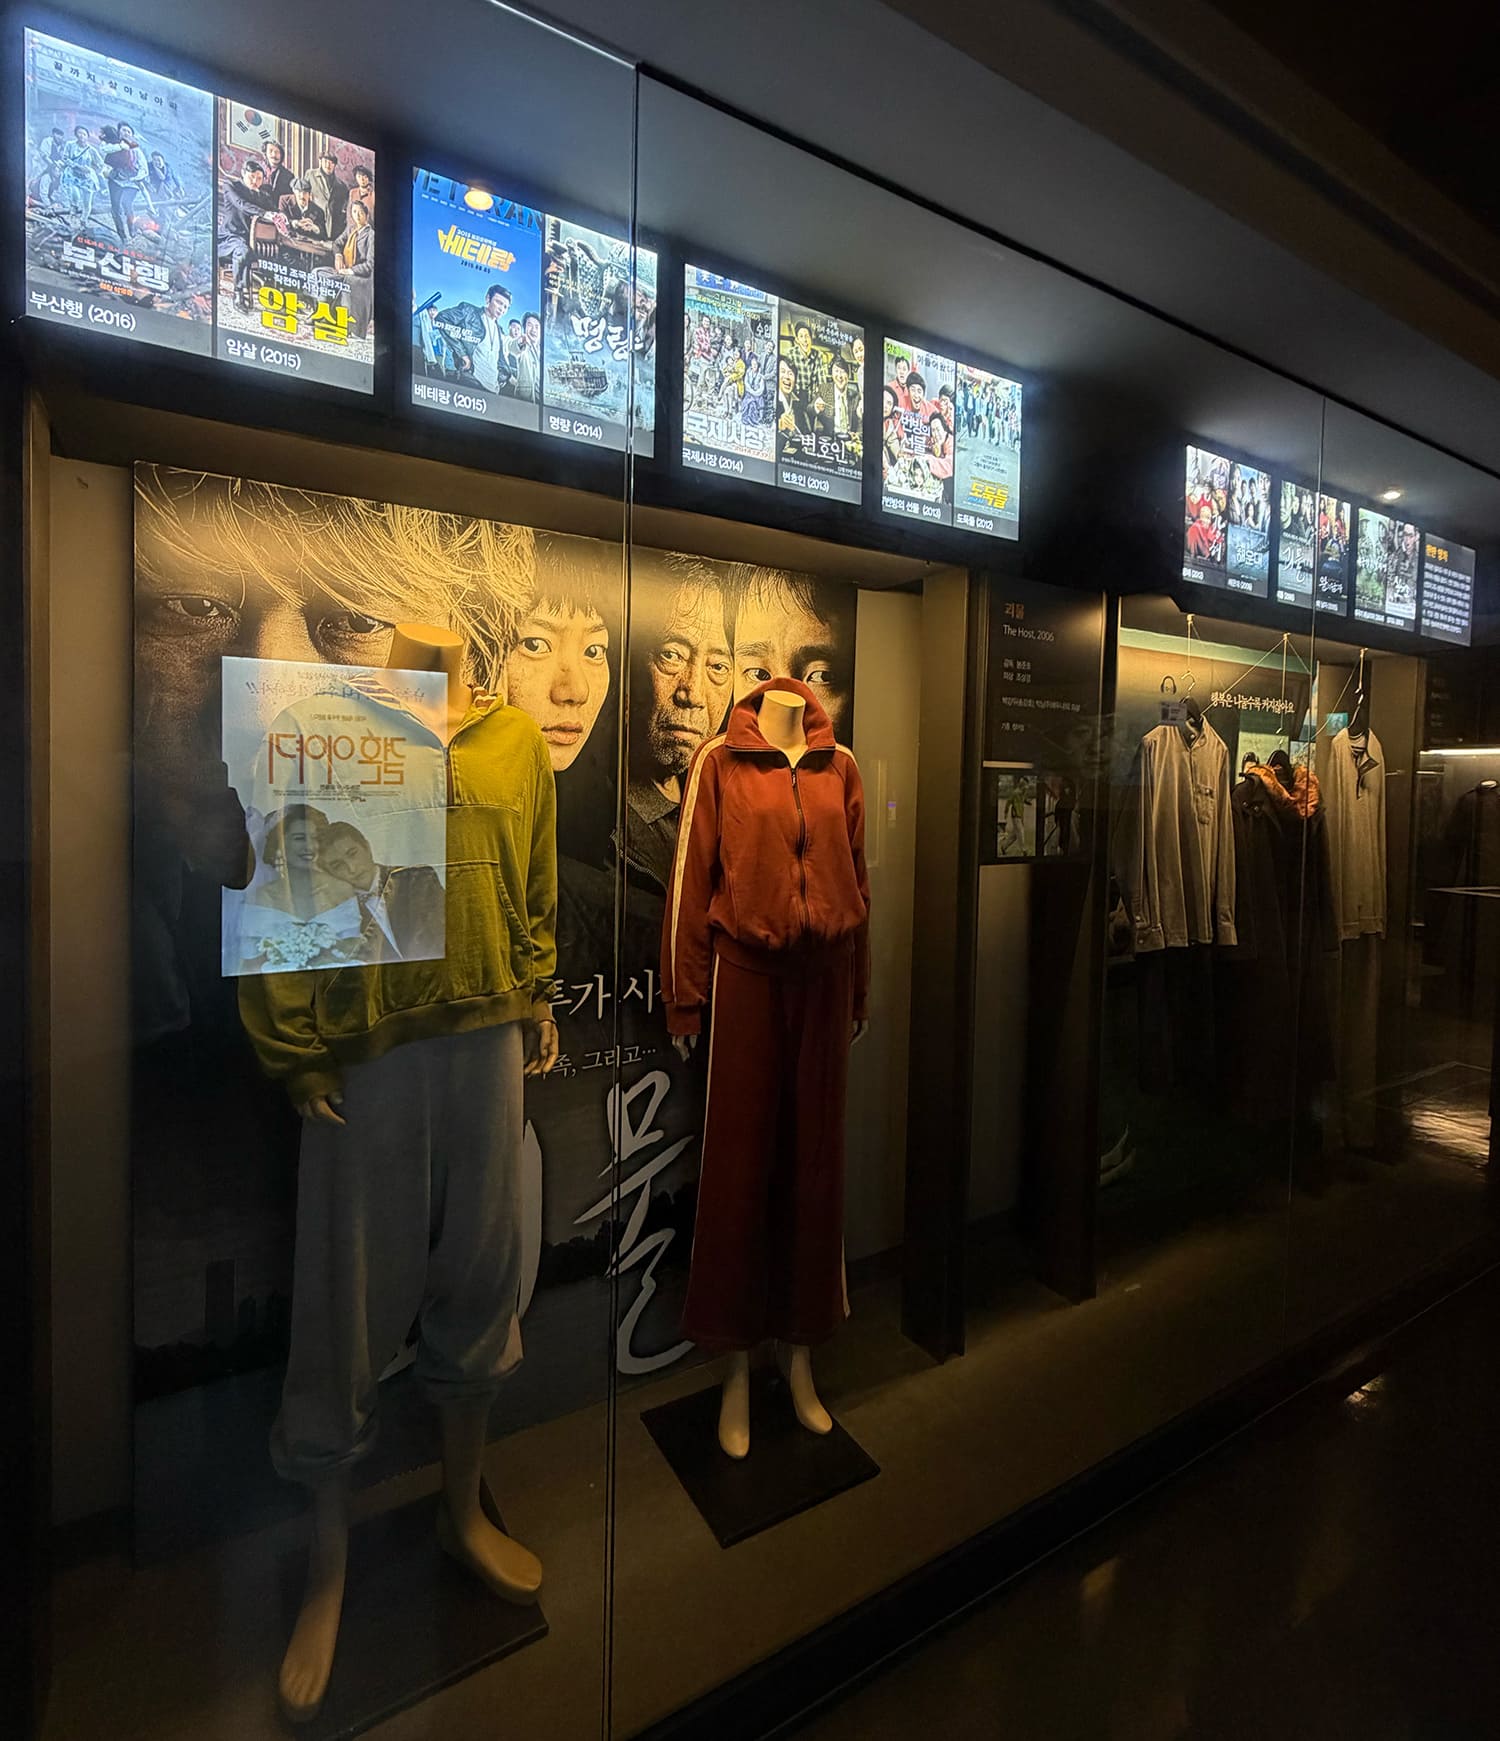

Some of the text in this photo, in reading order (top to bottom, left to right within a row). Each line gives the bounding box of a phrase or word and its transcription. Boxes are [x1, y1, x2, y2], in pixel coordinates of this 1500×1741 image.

[437, 224, 516, 272] 베테랑
[61, 239, 170, 293] 부산행
[257, 258, 288, 276] 1933년
[30, 290, 137, 332] 부산행 (2016)
[258, 286, 357, 347] 암살
[569, 314, 645, 362] 명량
[226, 338, 302, 371] 암살 (2015)
[414, 383, 487, 414] 베테랑 (2015)
[549, 415, 603, 441] 명량 (2014)
[686, 410, 768, 453] 국제시장
[682, 447, 718, 467] 국제시장
[718, 455, 744, 473] (2014)
[801, 432, 849, 465] 변호인
[782, 471, 830, 493] 변호인 (2013)
[968, 481, 1009, 510] 도둑들
[1004, 601, 1025, 620] 괴물
[1002, 624, 1055, 643] The Host, 2006
[1210, 691, 1295, 715] 행복은 나눌수록 커지잖아요
